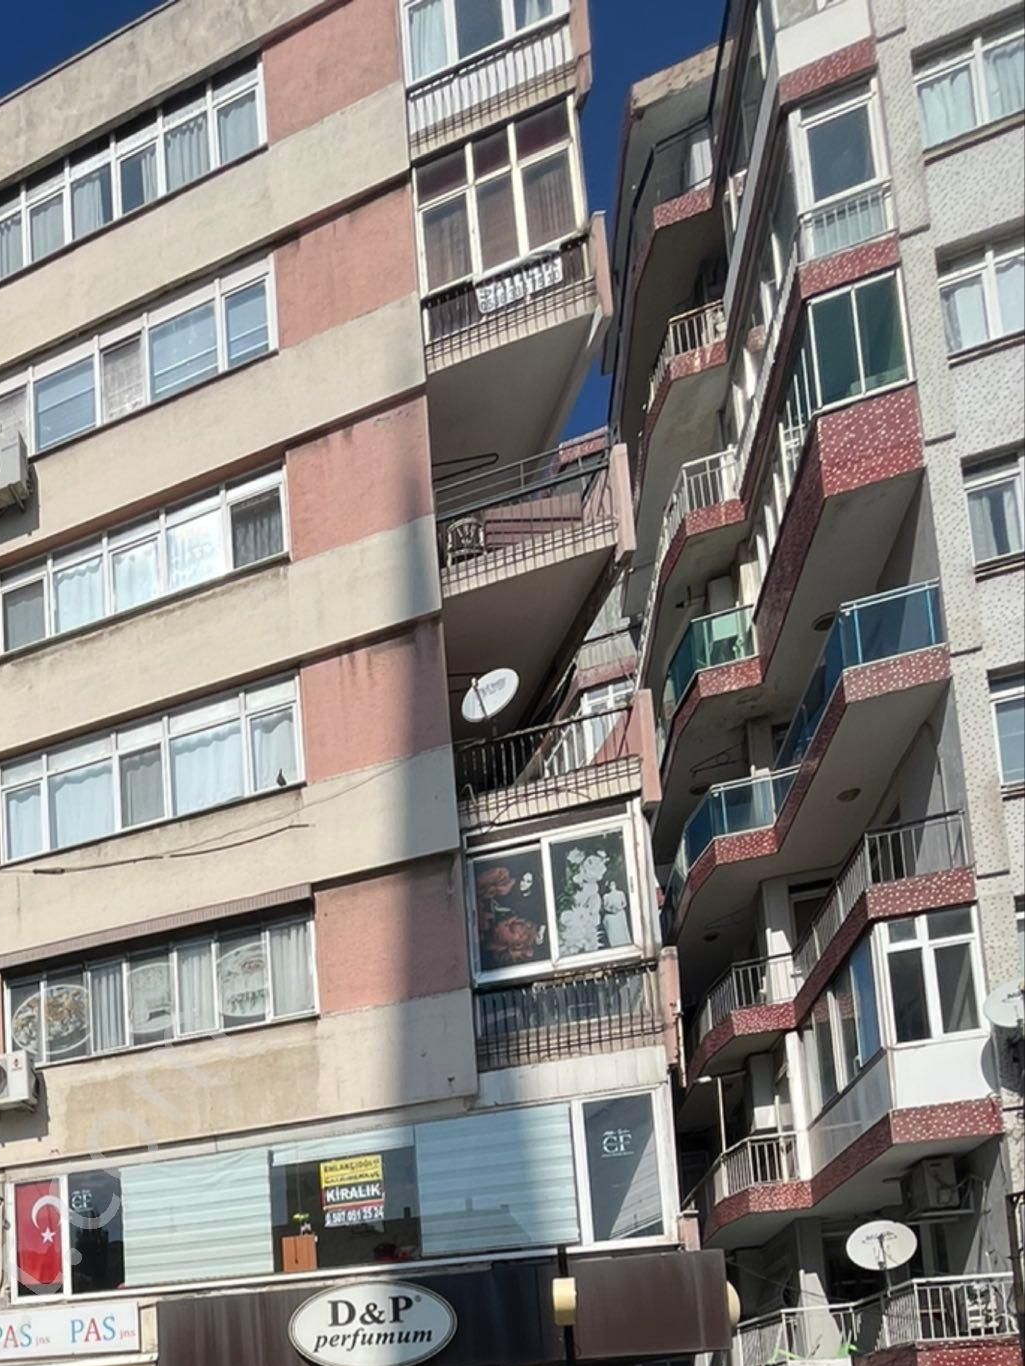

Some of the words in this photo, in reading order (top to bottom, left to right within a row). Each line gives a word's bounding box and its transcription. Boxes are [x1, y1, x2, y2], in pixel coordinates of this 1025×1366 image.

[326, 1183, 381, 1202] KİRALIK
[70, 1316, 116, 1343] PAS
[313, 1328, 433, 1353] perfumum
